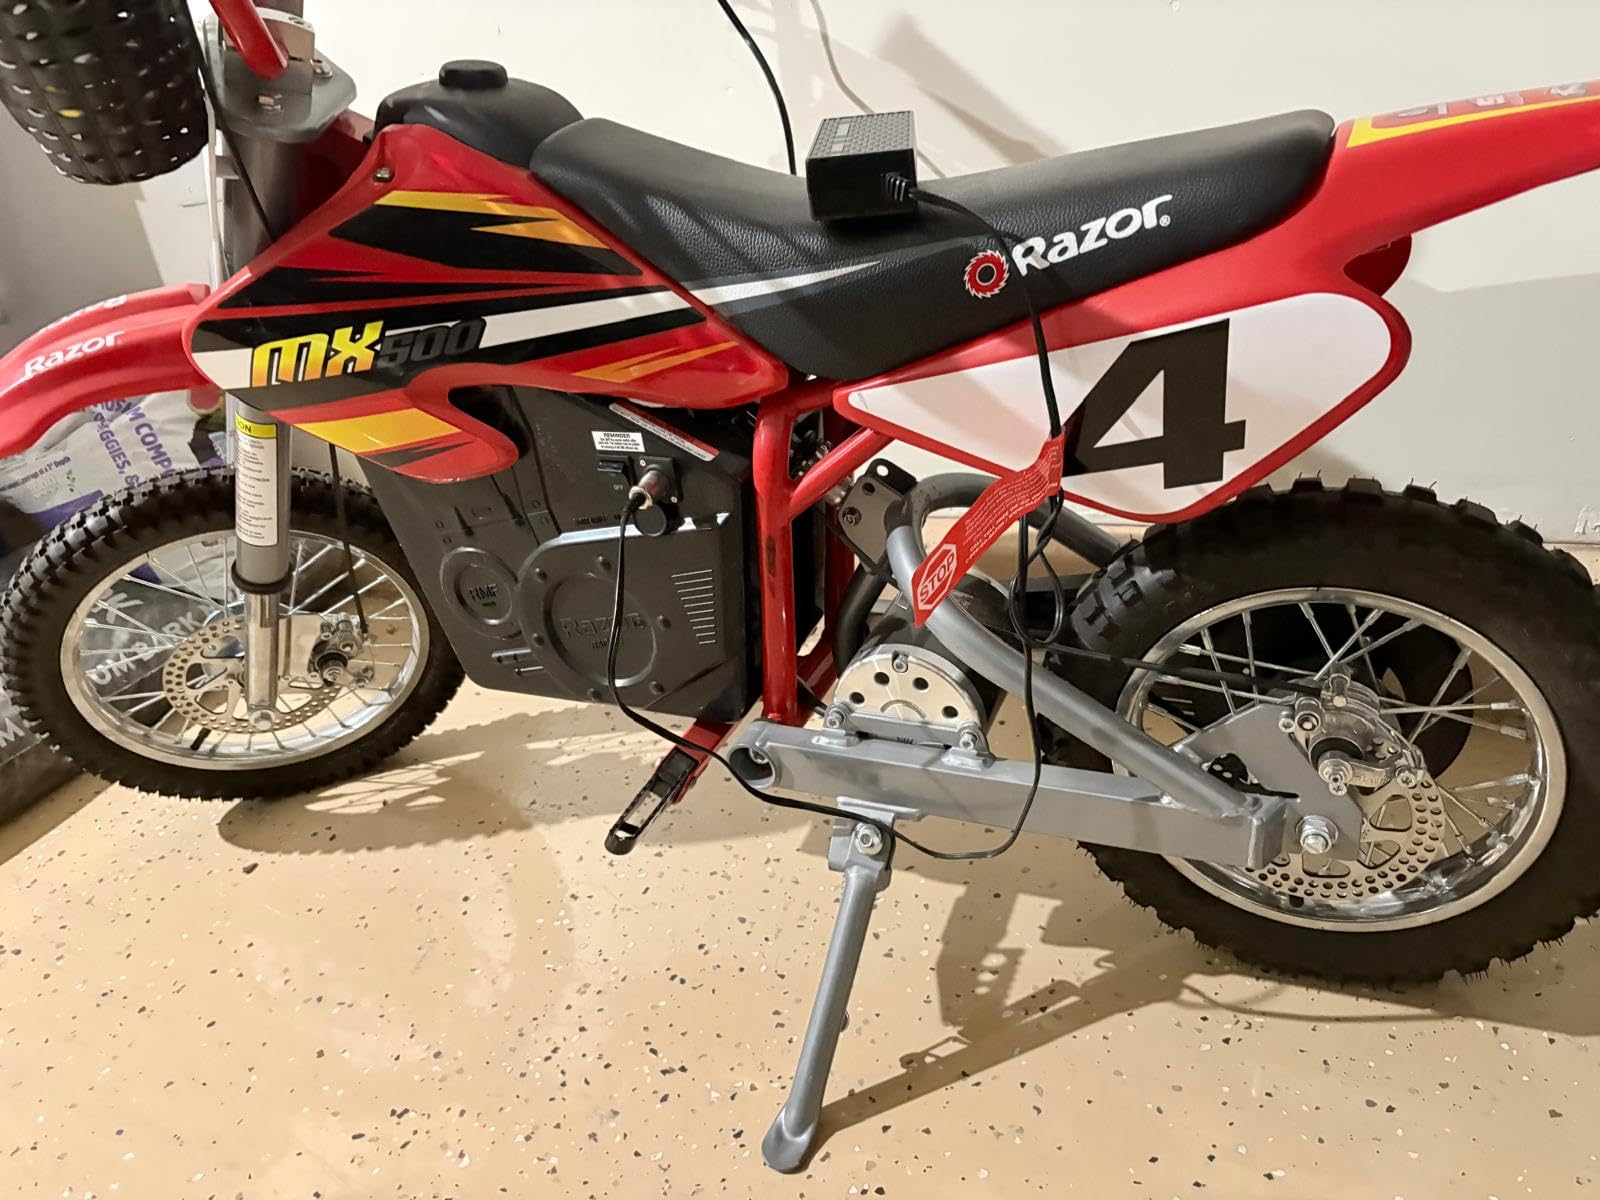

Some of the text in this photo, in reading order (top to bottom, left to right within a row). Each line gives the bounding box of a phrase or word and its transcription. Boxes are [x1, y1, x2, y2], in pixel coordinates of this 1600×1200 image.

[1012, 194, 1172, 277] Razor
[23, 331, 125, 379] Razor
[1062, 318, 1246, 489] 4
[919, 553, 956, 602] STOP
